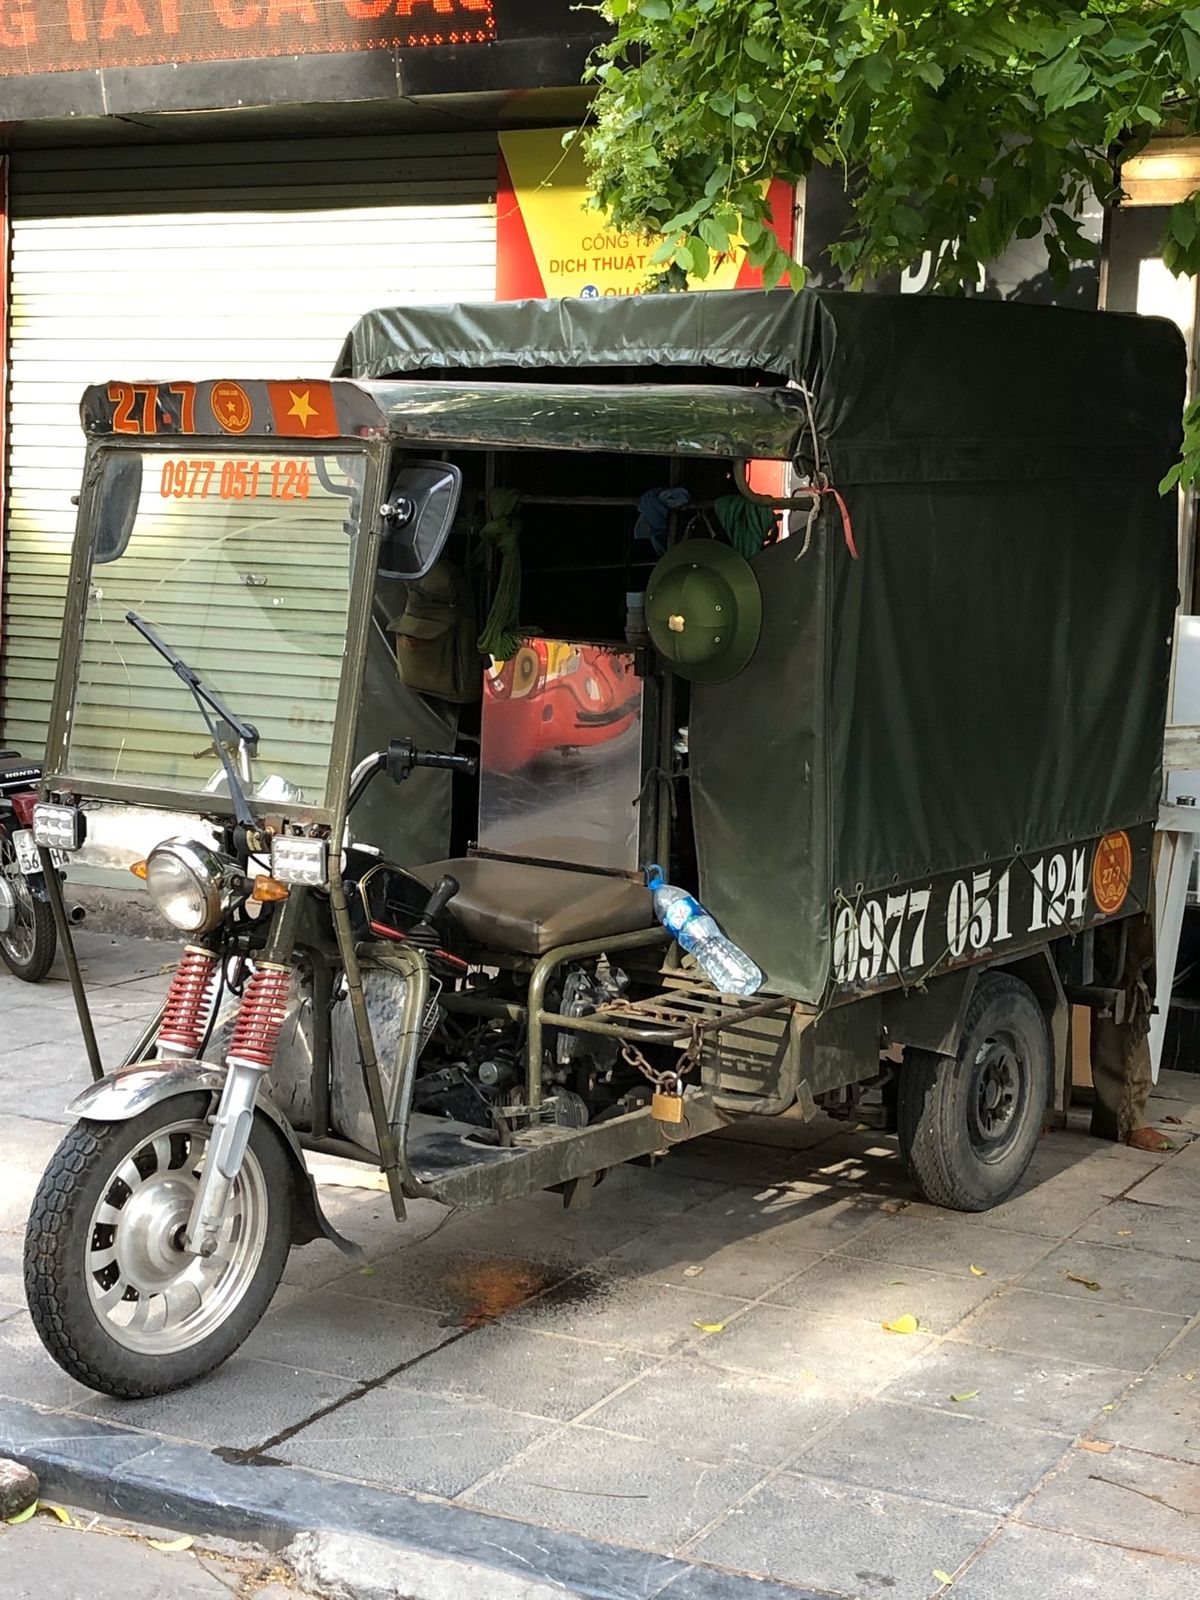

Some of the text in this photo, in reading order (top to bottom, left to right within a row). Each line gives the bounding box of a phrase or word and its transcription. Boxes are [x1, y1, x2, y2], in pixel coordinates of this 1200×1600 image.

[582, 233, 629, 251] CÔNG
[550, 259, 587, 276] DỊCH
[592, 254, 646, 273] THUẬT
[160, 460, 311, 499] 0977 051 124
[5, 769, 40, 779] HONDA
[833, 846, 1088, 984] 0977 051 124
